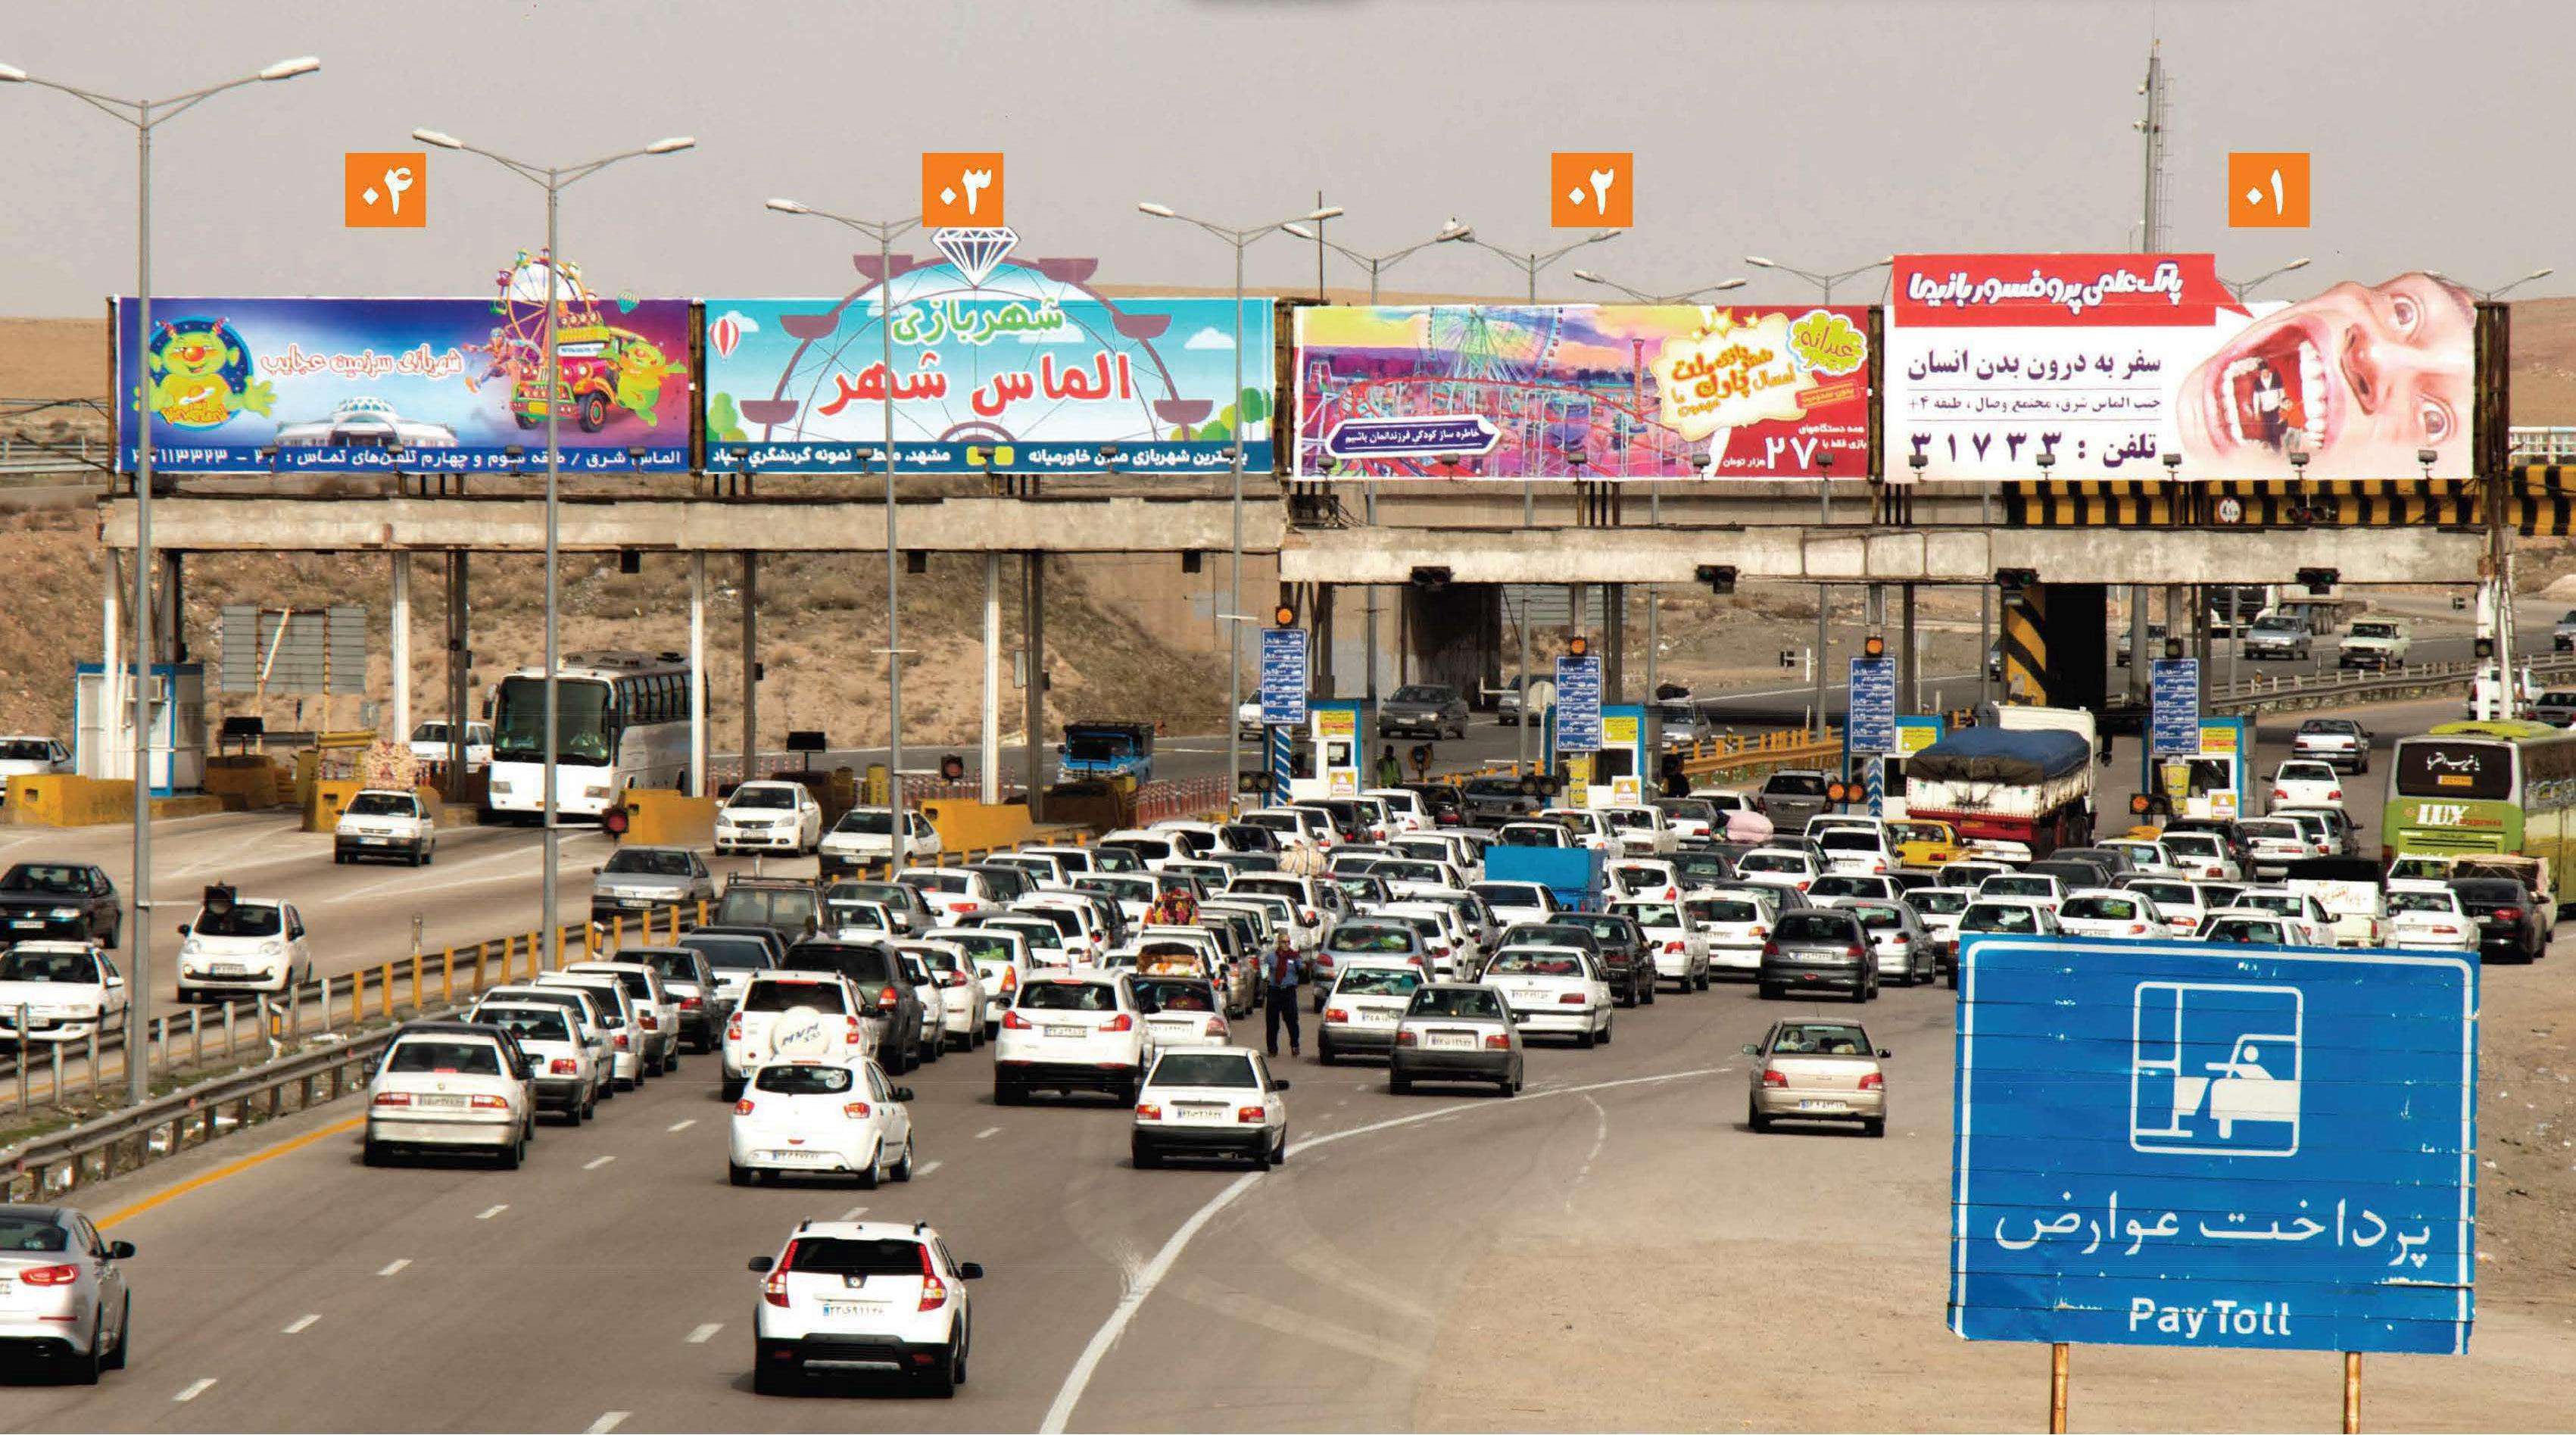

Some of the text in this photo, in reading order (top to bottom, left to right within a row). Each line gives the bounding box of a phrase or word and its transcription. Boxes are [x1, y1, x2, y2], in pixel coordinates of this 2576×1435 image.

[891, 296, 1065, 344] شهربازی
[260, 343, 466, 379] شهربازی سرزمین عجایب
[1907, 349, 2160, 380] سفر به درون بدن انسان
[817, 351, 1132, 417] الماس شهر
[1934, 398, 1961, 410] طبقه
[1976, 398, 2007, 413] وصال
[2092, 398, 2130, 412] الماس
[1439, 429, 1455, 442] ساز
[297, 449, 347, 466] تماس
[532, 450, 566, 464] طقه
[585, 449, 625, 467] شرق
[815, 448, 851, 464] نمونه
[1028, 448, 1090, 466] خاورمیانه
[1132, 448, 1190, 466] شهربازی
[1765, 436, 1818, 469] ۲۷
[2103, 432, 2157, 469] تلفن
[421, 453, 466, 469] چهارم
[2416, 804, 2469, 826] LUX
[1994, 1190, 2431, 1268] پرداخت عوارض
